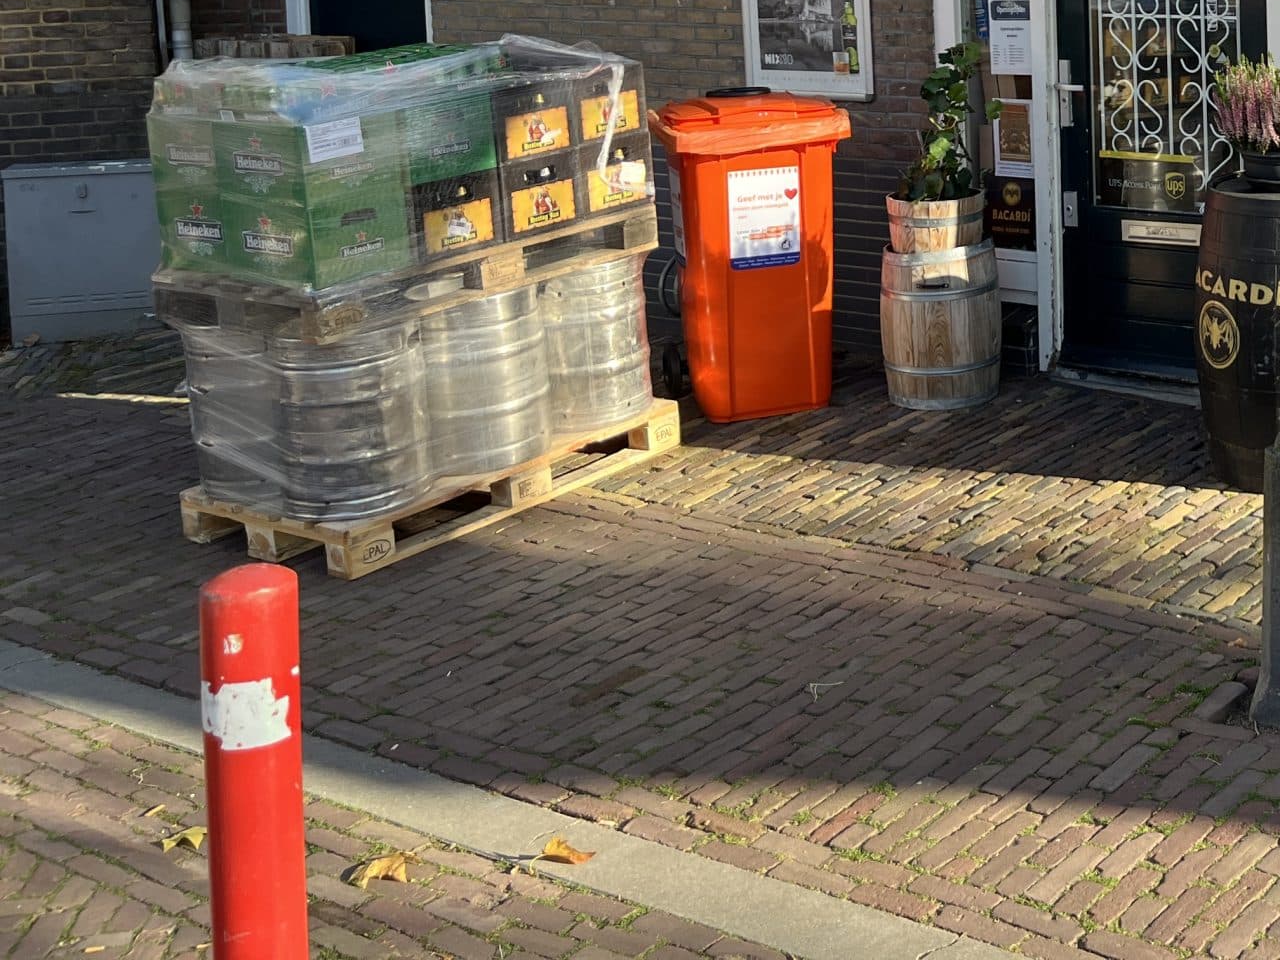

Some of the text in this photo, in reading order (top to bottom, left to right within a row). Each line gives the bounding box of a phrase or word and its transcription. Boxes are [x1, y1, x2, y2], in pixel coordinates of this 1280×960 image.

[236, 155, 281, 172] Heineken
[1108, 178, 1122, 187] UPS
[1167, 179, 1184, 195] ups
[177, 221, 220, 238] Heineken
[245, 235, 291, 253] Heineken
[342, 241, 383, 258] Heineken
[655, 428, 673, 442] EPAL
[362, 543, 387, 560] EPAL
